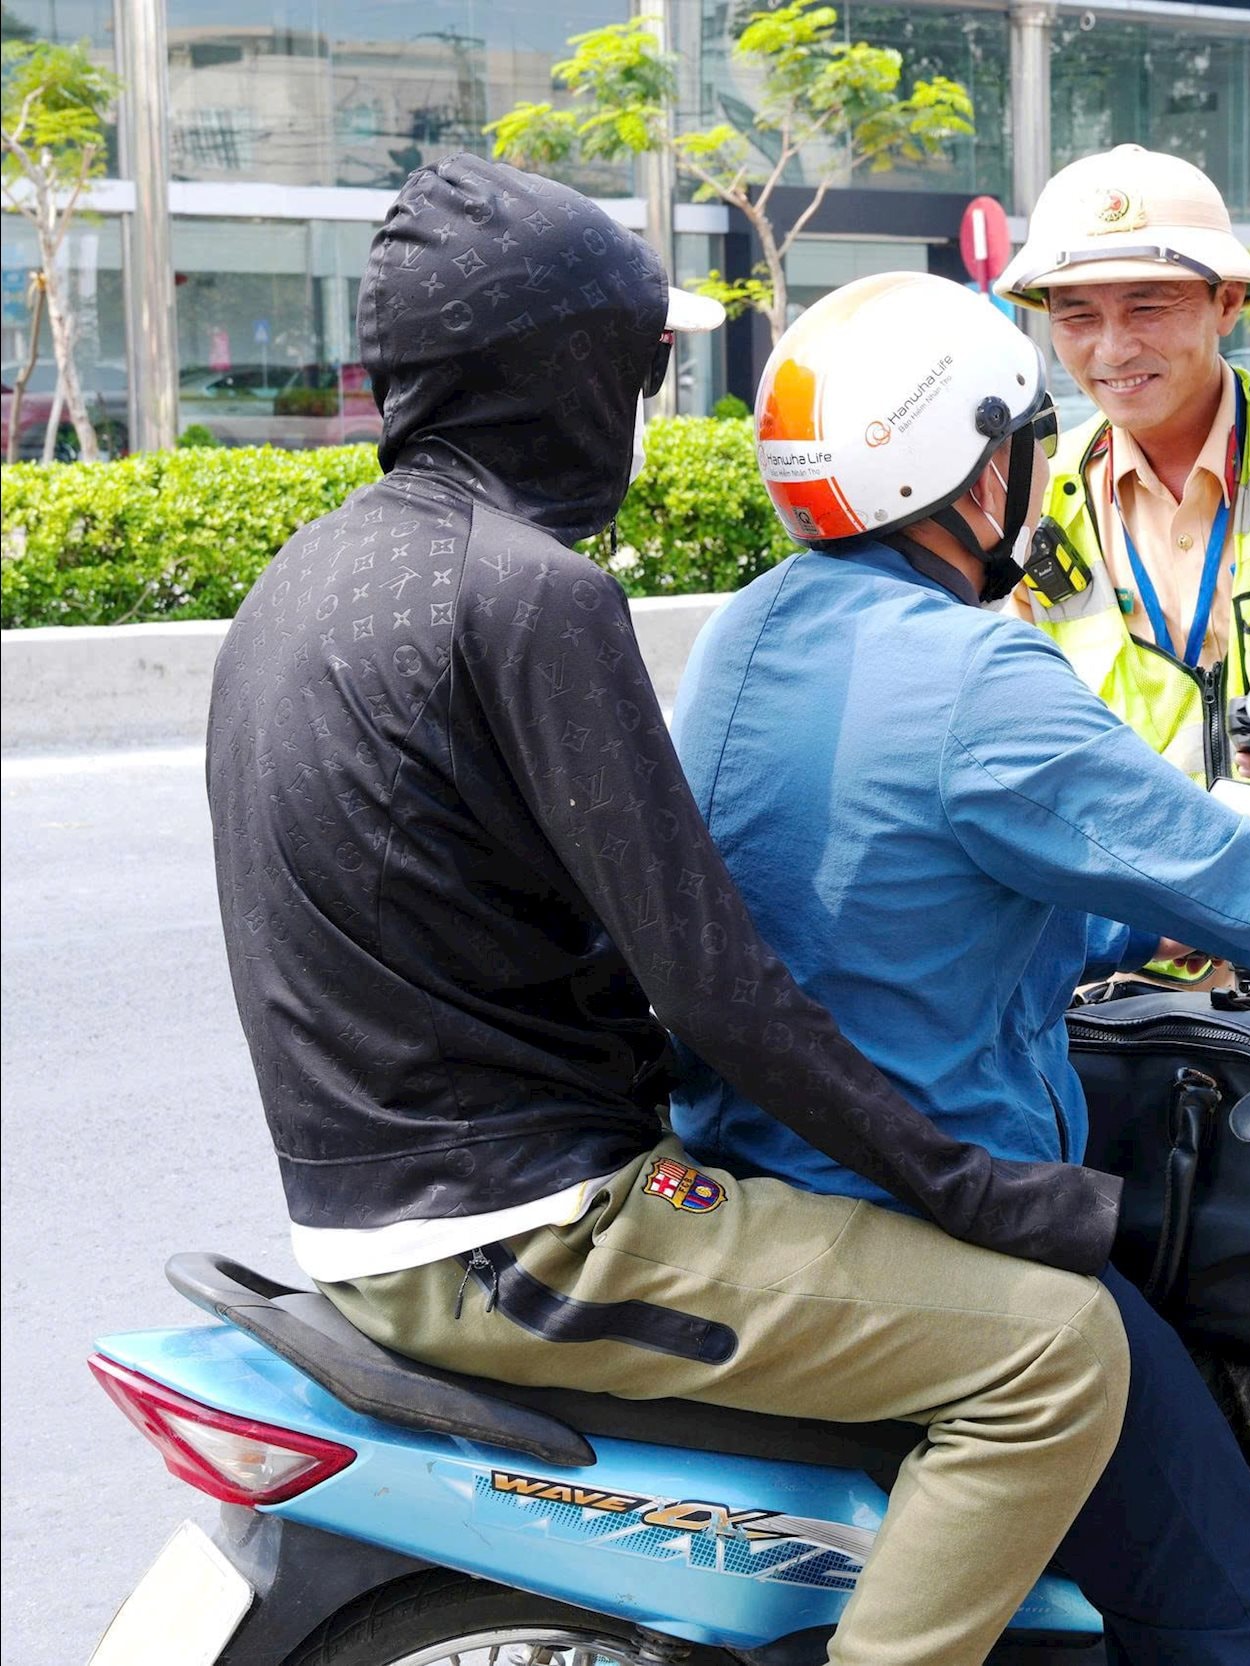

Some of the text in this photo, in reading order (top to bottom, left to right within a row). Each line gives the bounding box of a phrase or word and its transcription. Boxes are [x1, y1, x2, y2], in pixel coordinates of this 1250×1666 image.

[887, 354, 954, 426] Hanwha Life
[767, 452, 832, 466] Hanwha Life
[679, 1177, 692, 1194] FCB
[493, 1472, 636, 1512] WAVE
